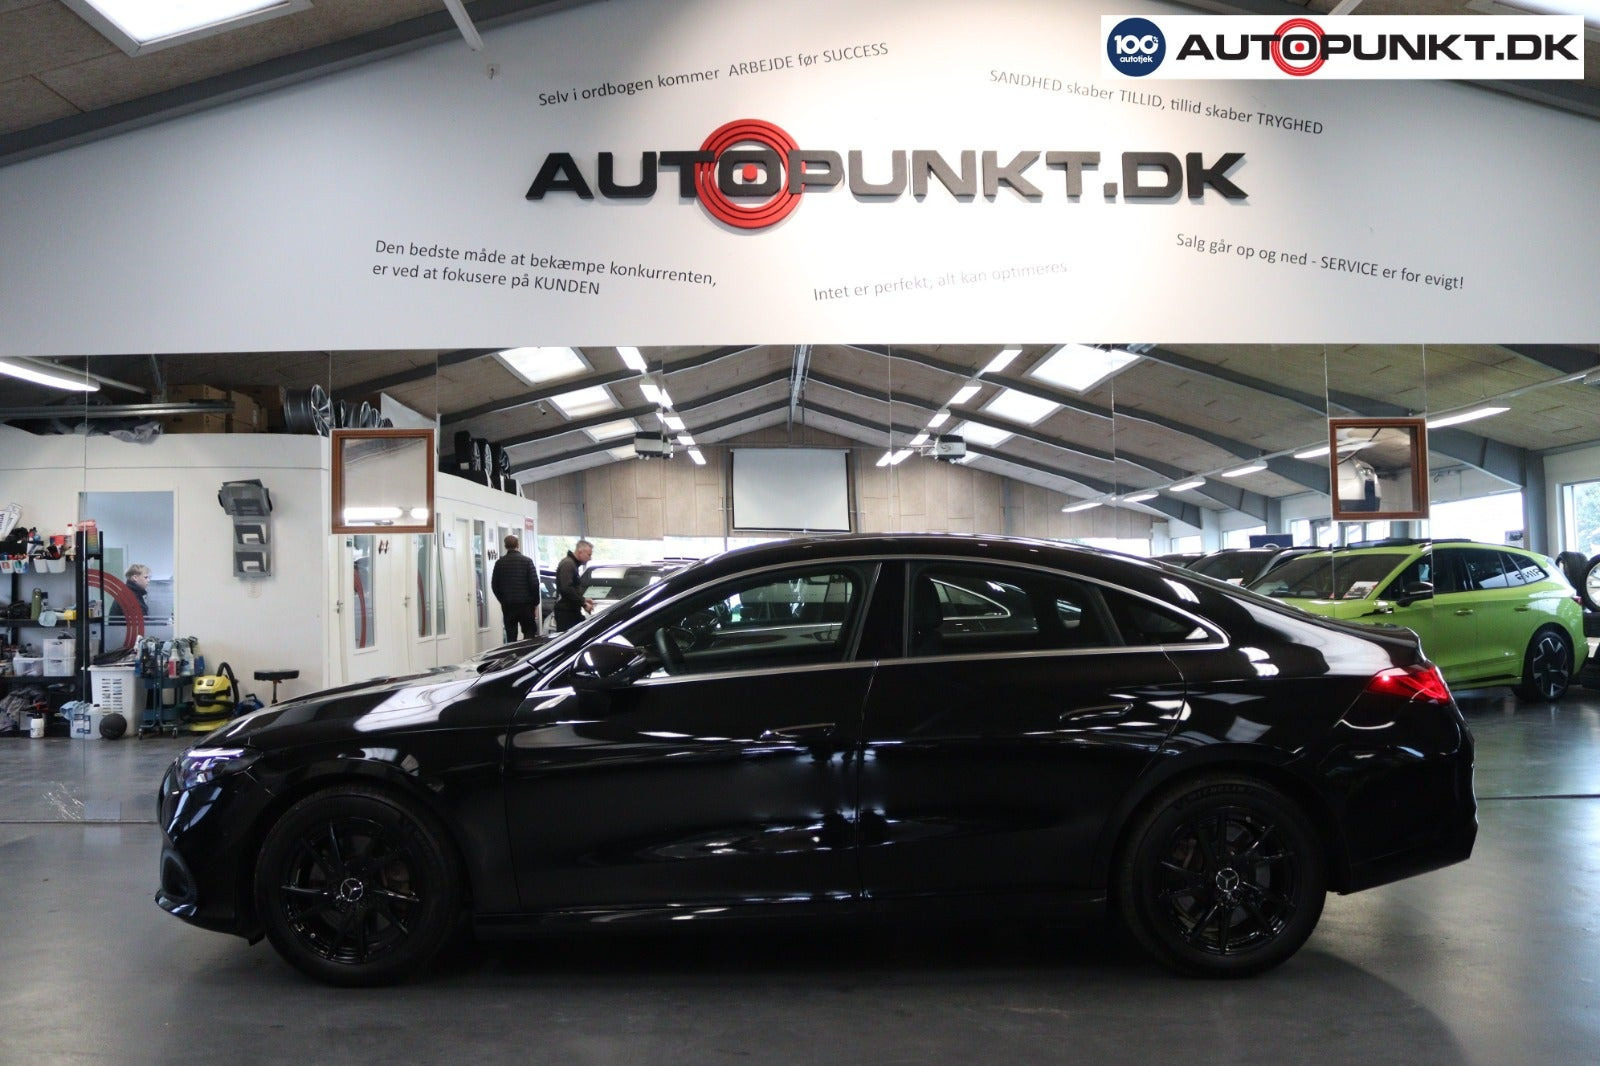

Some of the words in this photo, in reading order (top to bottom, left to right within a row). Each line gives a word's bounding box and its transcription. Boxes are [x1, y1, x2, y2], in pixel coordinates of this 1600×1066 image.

[538, 89, 570, 106] Selv
[572, 87, 578, 101] i
[581, 77, 654, 99] ordbogen
[657, 67, 720, 88] kommer
[728, 55, 794, 77] ARBEJDE
[797, 52, 819, 67] før
[823, 41, 889, 63] SUCCESS
[990, 69, 1062, 92] SANDHED
[1067, 82, 1114, 101] skaber
[1119, 89, 1167, 111] TILLID,
[1170, 98, 1201, 115] tillid
[1204, 103, 1253, 123] skaber
[1256, 112, 1324, 135] TRYGHED
[525, 150, 1250, 202] AUTOPUNKT.DK
[372, 263, 389, 276] er
[392, 263, 419, 279] ved
[422, 268, 438, 280] at
[441, 267, 508, 286] fokusere
[510, 271, 530, 289] på
[534, 276, 601, 296] KUNDEN
[375, 239, 405, 256] Den
[408, 242, 460, 261] bedste
[463, 247, 507, 266] måde
[511, 253, 526, 267] at
[530, 252, 606, 276] bekæmpe
[609, 260, 718, 288] konkurrenten,
[813, 286, 850, 302] Intet
[853, 285, 870, 297] er
[873, 276, 934, 297] perfekt,
[937, 273, 956, 287] alt
[960, 271, 988, 285] kan
[1176, 233, 1206, 253] Salg
[1208, 239, 1234, 255] går
[1236, 245, 1256, 260] op
[1258, 248, 1277, 264] og
[1279, 251, 1308, 267] ned
[1320, 255, 1380, 277] SERVICE
[1381, 265, 1398, 281] er
[1400, 266, 1422, 284] for
[1424, 273, 1465, 292] evigt!
